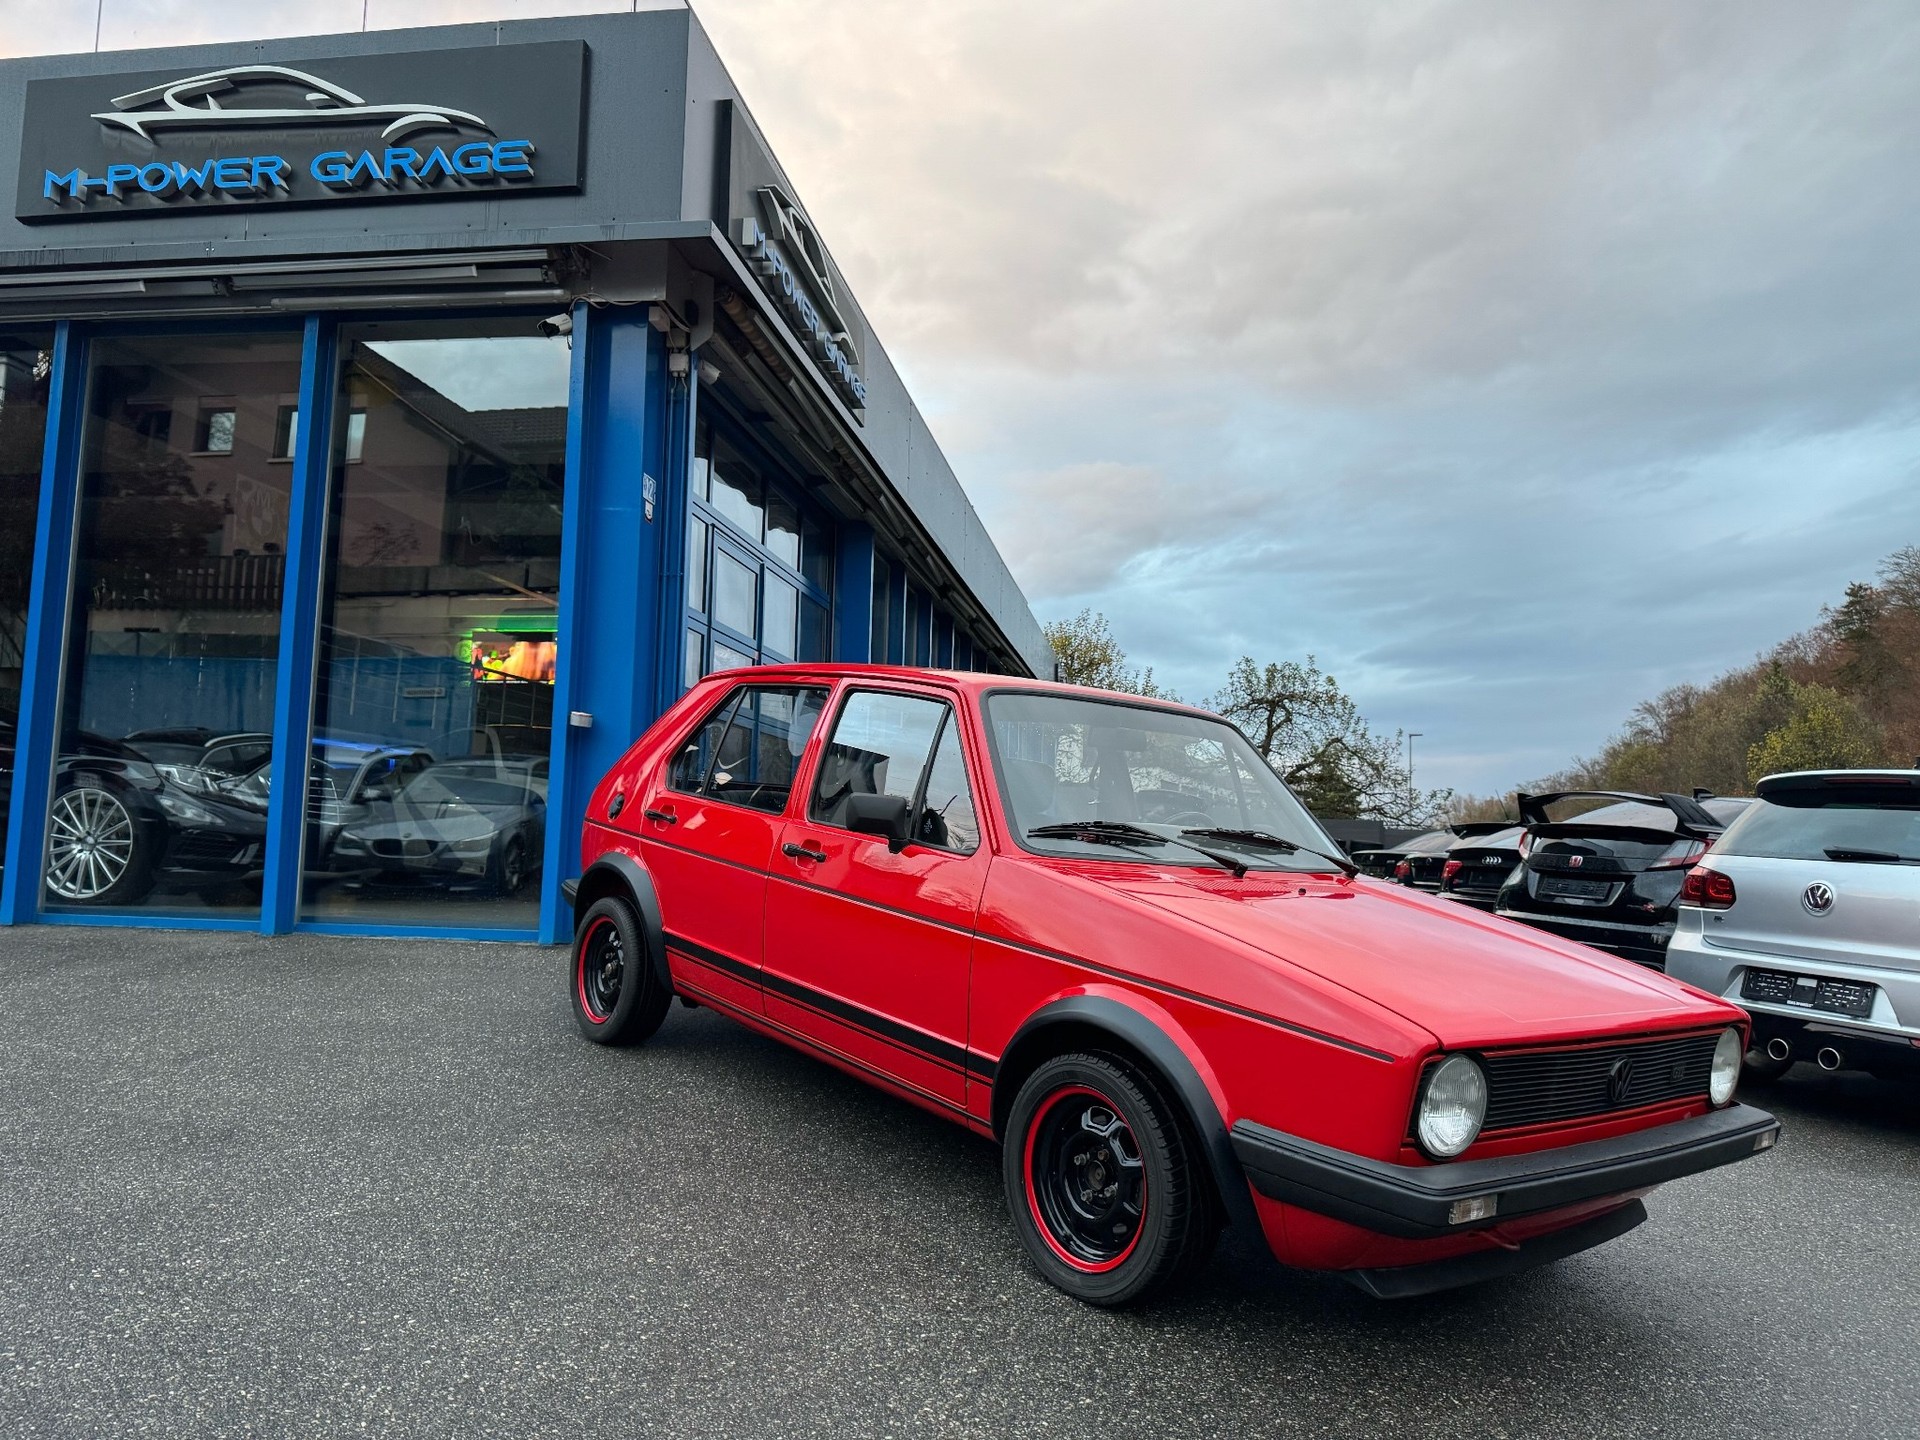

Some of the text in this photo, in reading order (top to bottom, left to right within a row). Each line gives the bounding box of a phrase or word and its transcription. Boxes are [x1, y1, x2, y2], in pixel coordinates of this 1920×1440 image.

[43, 139, 530, 198] M-POWER GARAGE
[753, 218, 867, 409] M-POWER GARAGE
